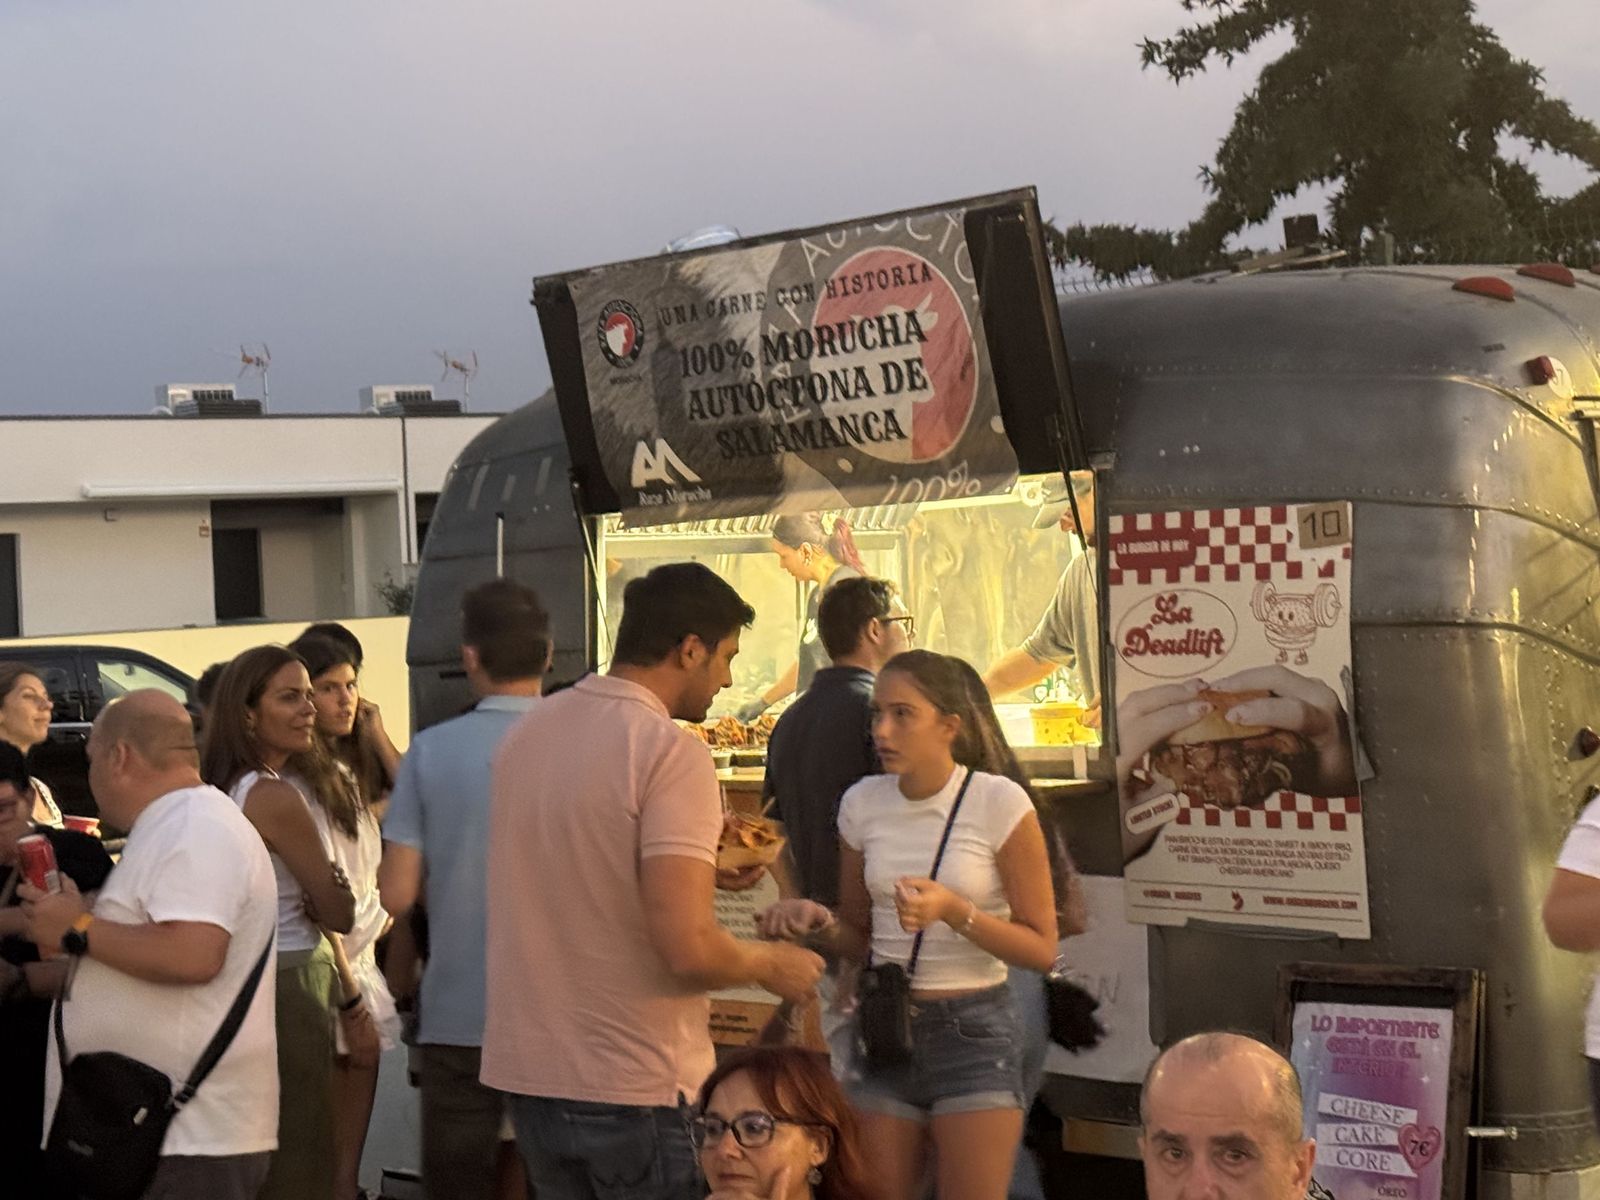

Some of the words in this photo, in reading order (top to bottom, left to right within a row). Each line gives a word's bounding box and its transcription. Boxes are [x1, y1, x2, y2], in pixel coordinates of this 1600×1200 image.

[661, 303, 699, 326] UNA
[706, 291, 767, 319] CARNE
[777, 282, 815, 307] CON
[825, 261, 933, 299] HISTORIA
[681, 338, 755, 378] 100%
[761, 308, 928, 366] MORUCHA
[688, 366, 876, 420] AUTÓCTONA
[879, 357, 929, 395] DE
[716, 408, 908, 460] SALAMANCA
[1303, 508, 1341, 540] 10
[1151, 592, 1193, 624] La
[1122, 623, 1225, 658] Deadlift
[1311, 1015, 1333, 1033] LO
[1331, 1099, 1404, 1126] CHEESE
[1335, 1126, 1387, 1145] CAKE
[1410, 1140, 1430, 1158] 7€
[1336, 1151, 1391, 1172] CORE
